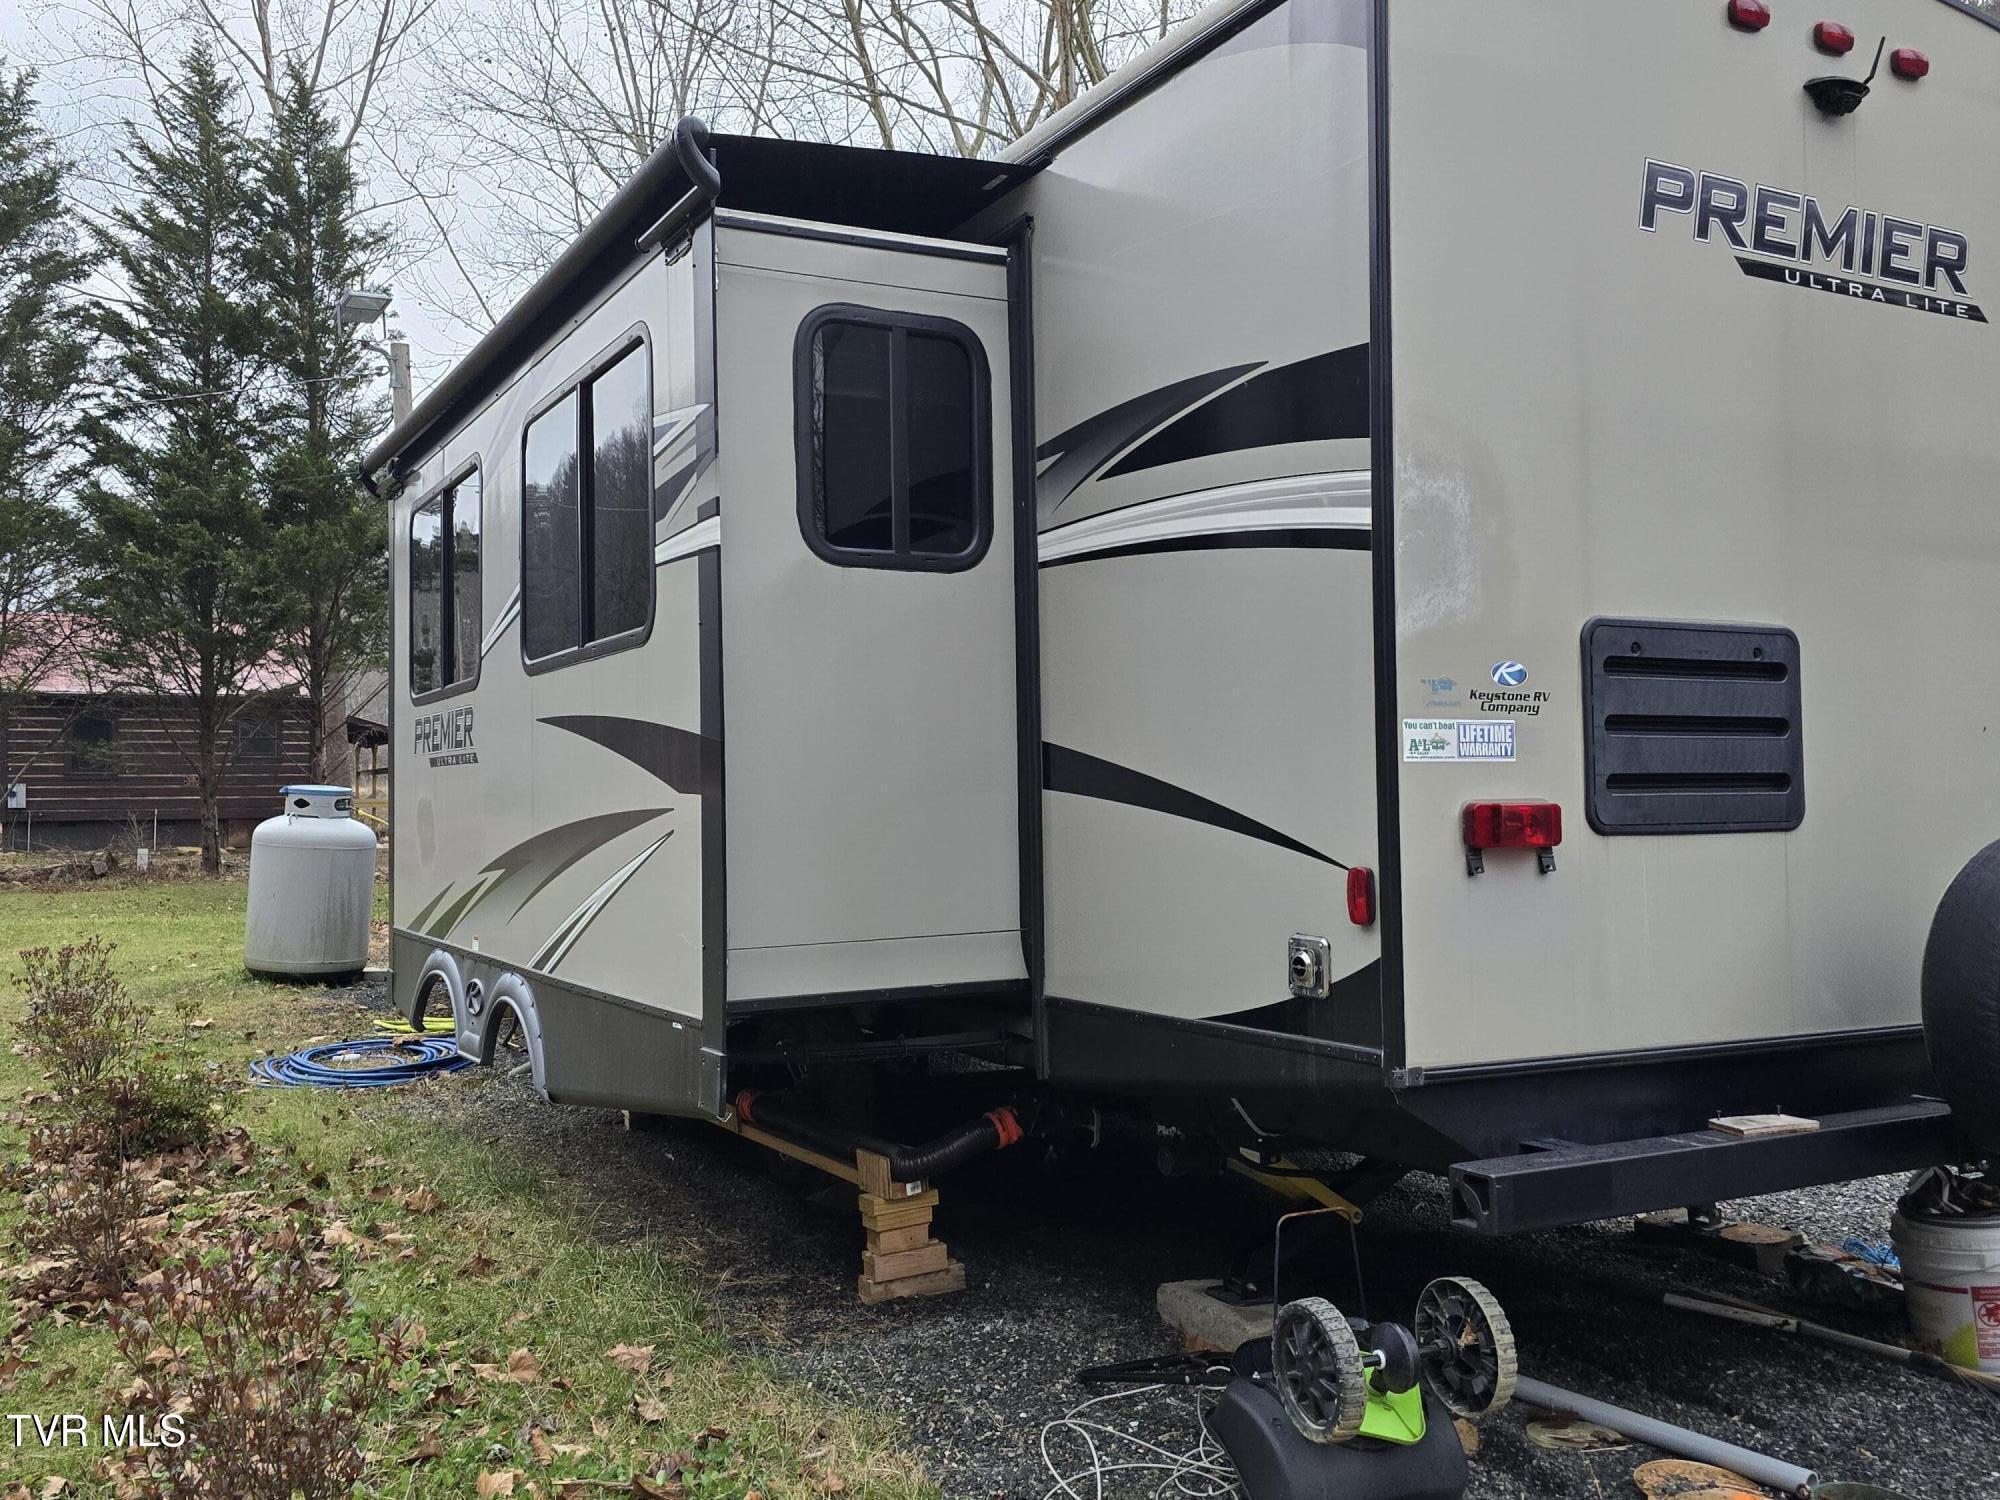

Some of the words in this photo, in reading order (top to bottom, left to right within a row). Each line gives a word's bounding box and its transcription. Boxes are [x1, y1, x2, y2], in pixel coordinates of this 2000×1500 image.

[1638, 157, 1973, 299] PREMIER
[1785, 269, 1886, 302] ULTRA
[1906, 294, 1969, 318] LITE
[1469, 689, 1530, 703] Keystone
[1533, 691, 1551, 702] RV
[1480, 701, 1540, 716] Company
[415, 706, 474, 755] PREMIER
[1404, 721, 1417, 730] You
[1419, 721, 1437, 730] can't
[1438, 721, 1456, 730] beat
[1459, 724, 1512, 743] LIFETIME
[1459, 742, 1512, 756] WARRANTY
[436, 756, 456, 766] ULTRA
[459, 754, 475, 763] LITE
